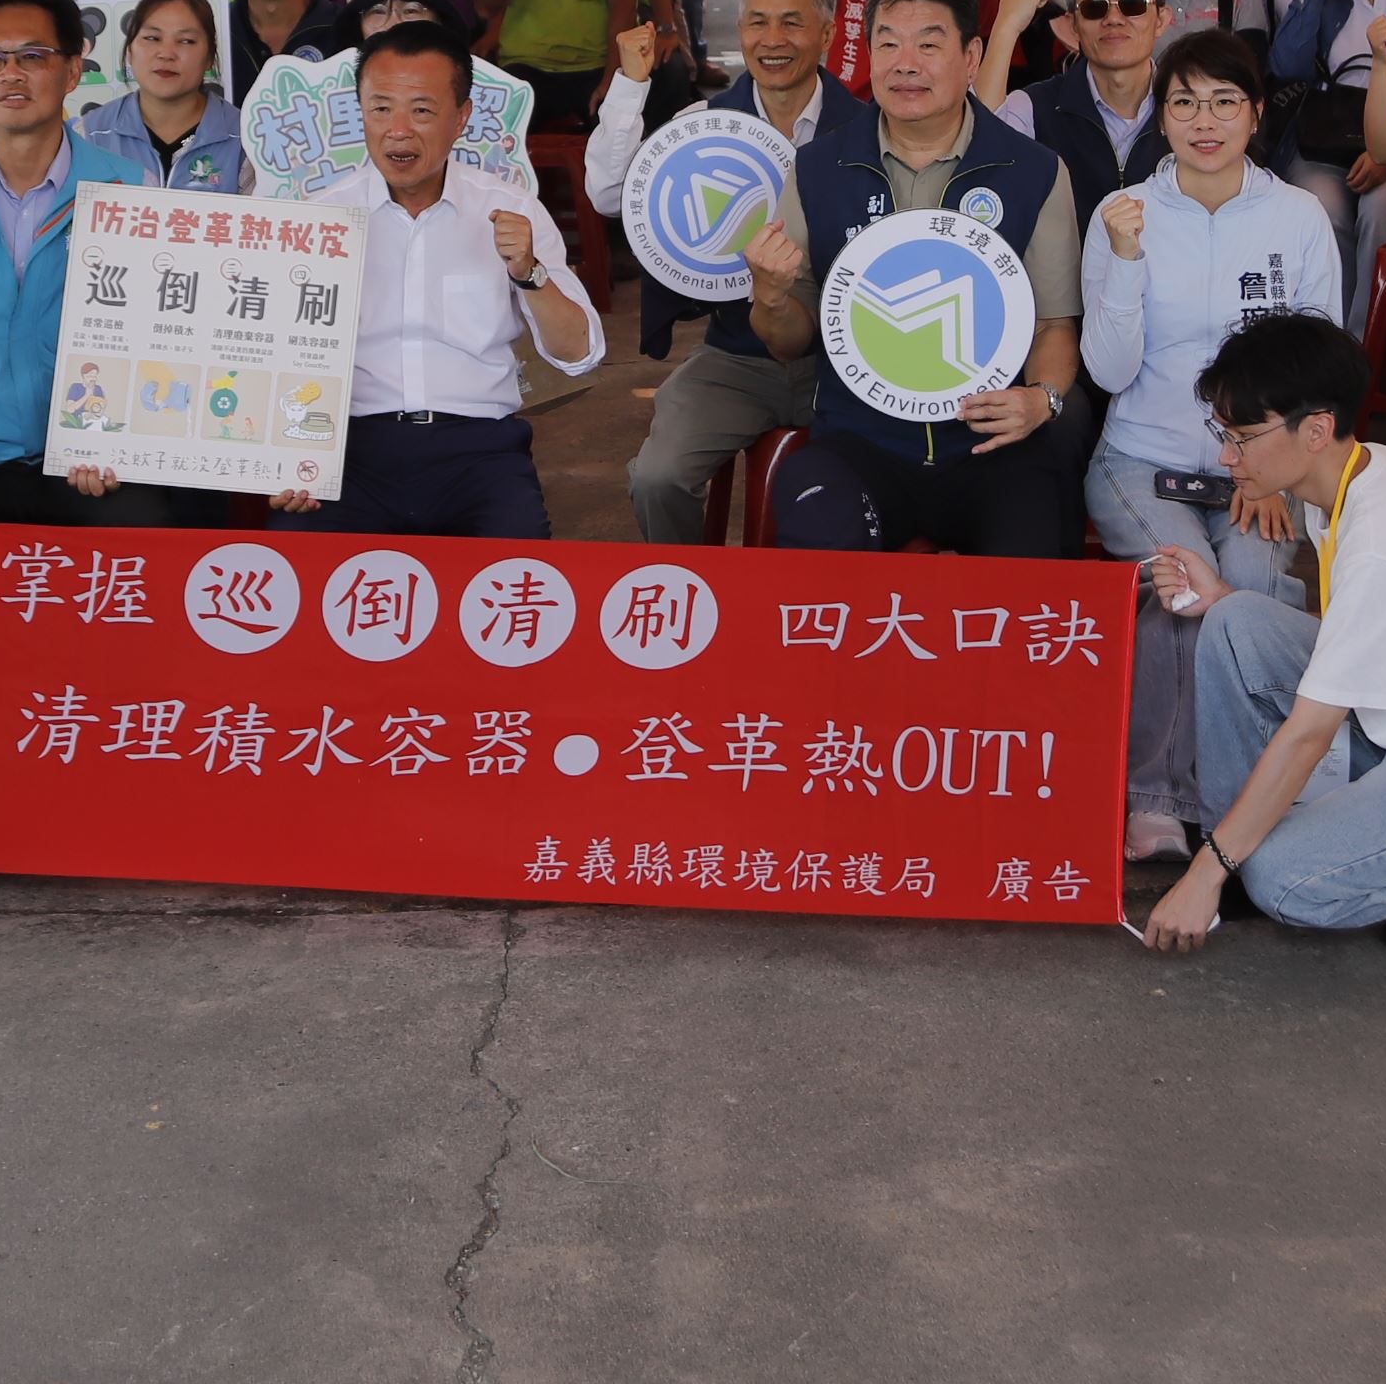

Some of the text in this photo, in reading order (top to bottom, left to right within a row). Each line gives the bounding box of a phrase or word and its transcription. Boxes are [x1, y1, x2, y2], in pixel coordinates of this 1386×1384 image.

[629, 117, 743, 217] 環境部環境管理署
[90, 200, 351, 259] 防治登革熱秘笈
[633, 222, 719, 290] Environmental
[928, 216, 1019, 279] 環境部
[85, 262, 339, 327] 巡 倒 清 刷
[826, 266, 856, 357] Ministry
[845, 364, 870, 384] of
[0, 541, 1105, 666] 掌握 巡 倒 清 刷 四大口訣
[523, 833, 1091, 904] 嘉義縣環境保護局 廣告
